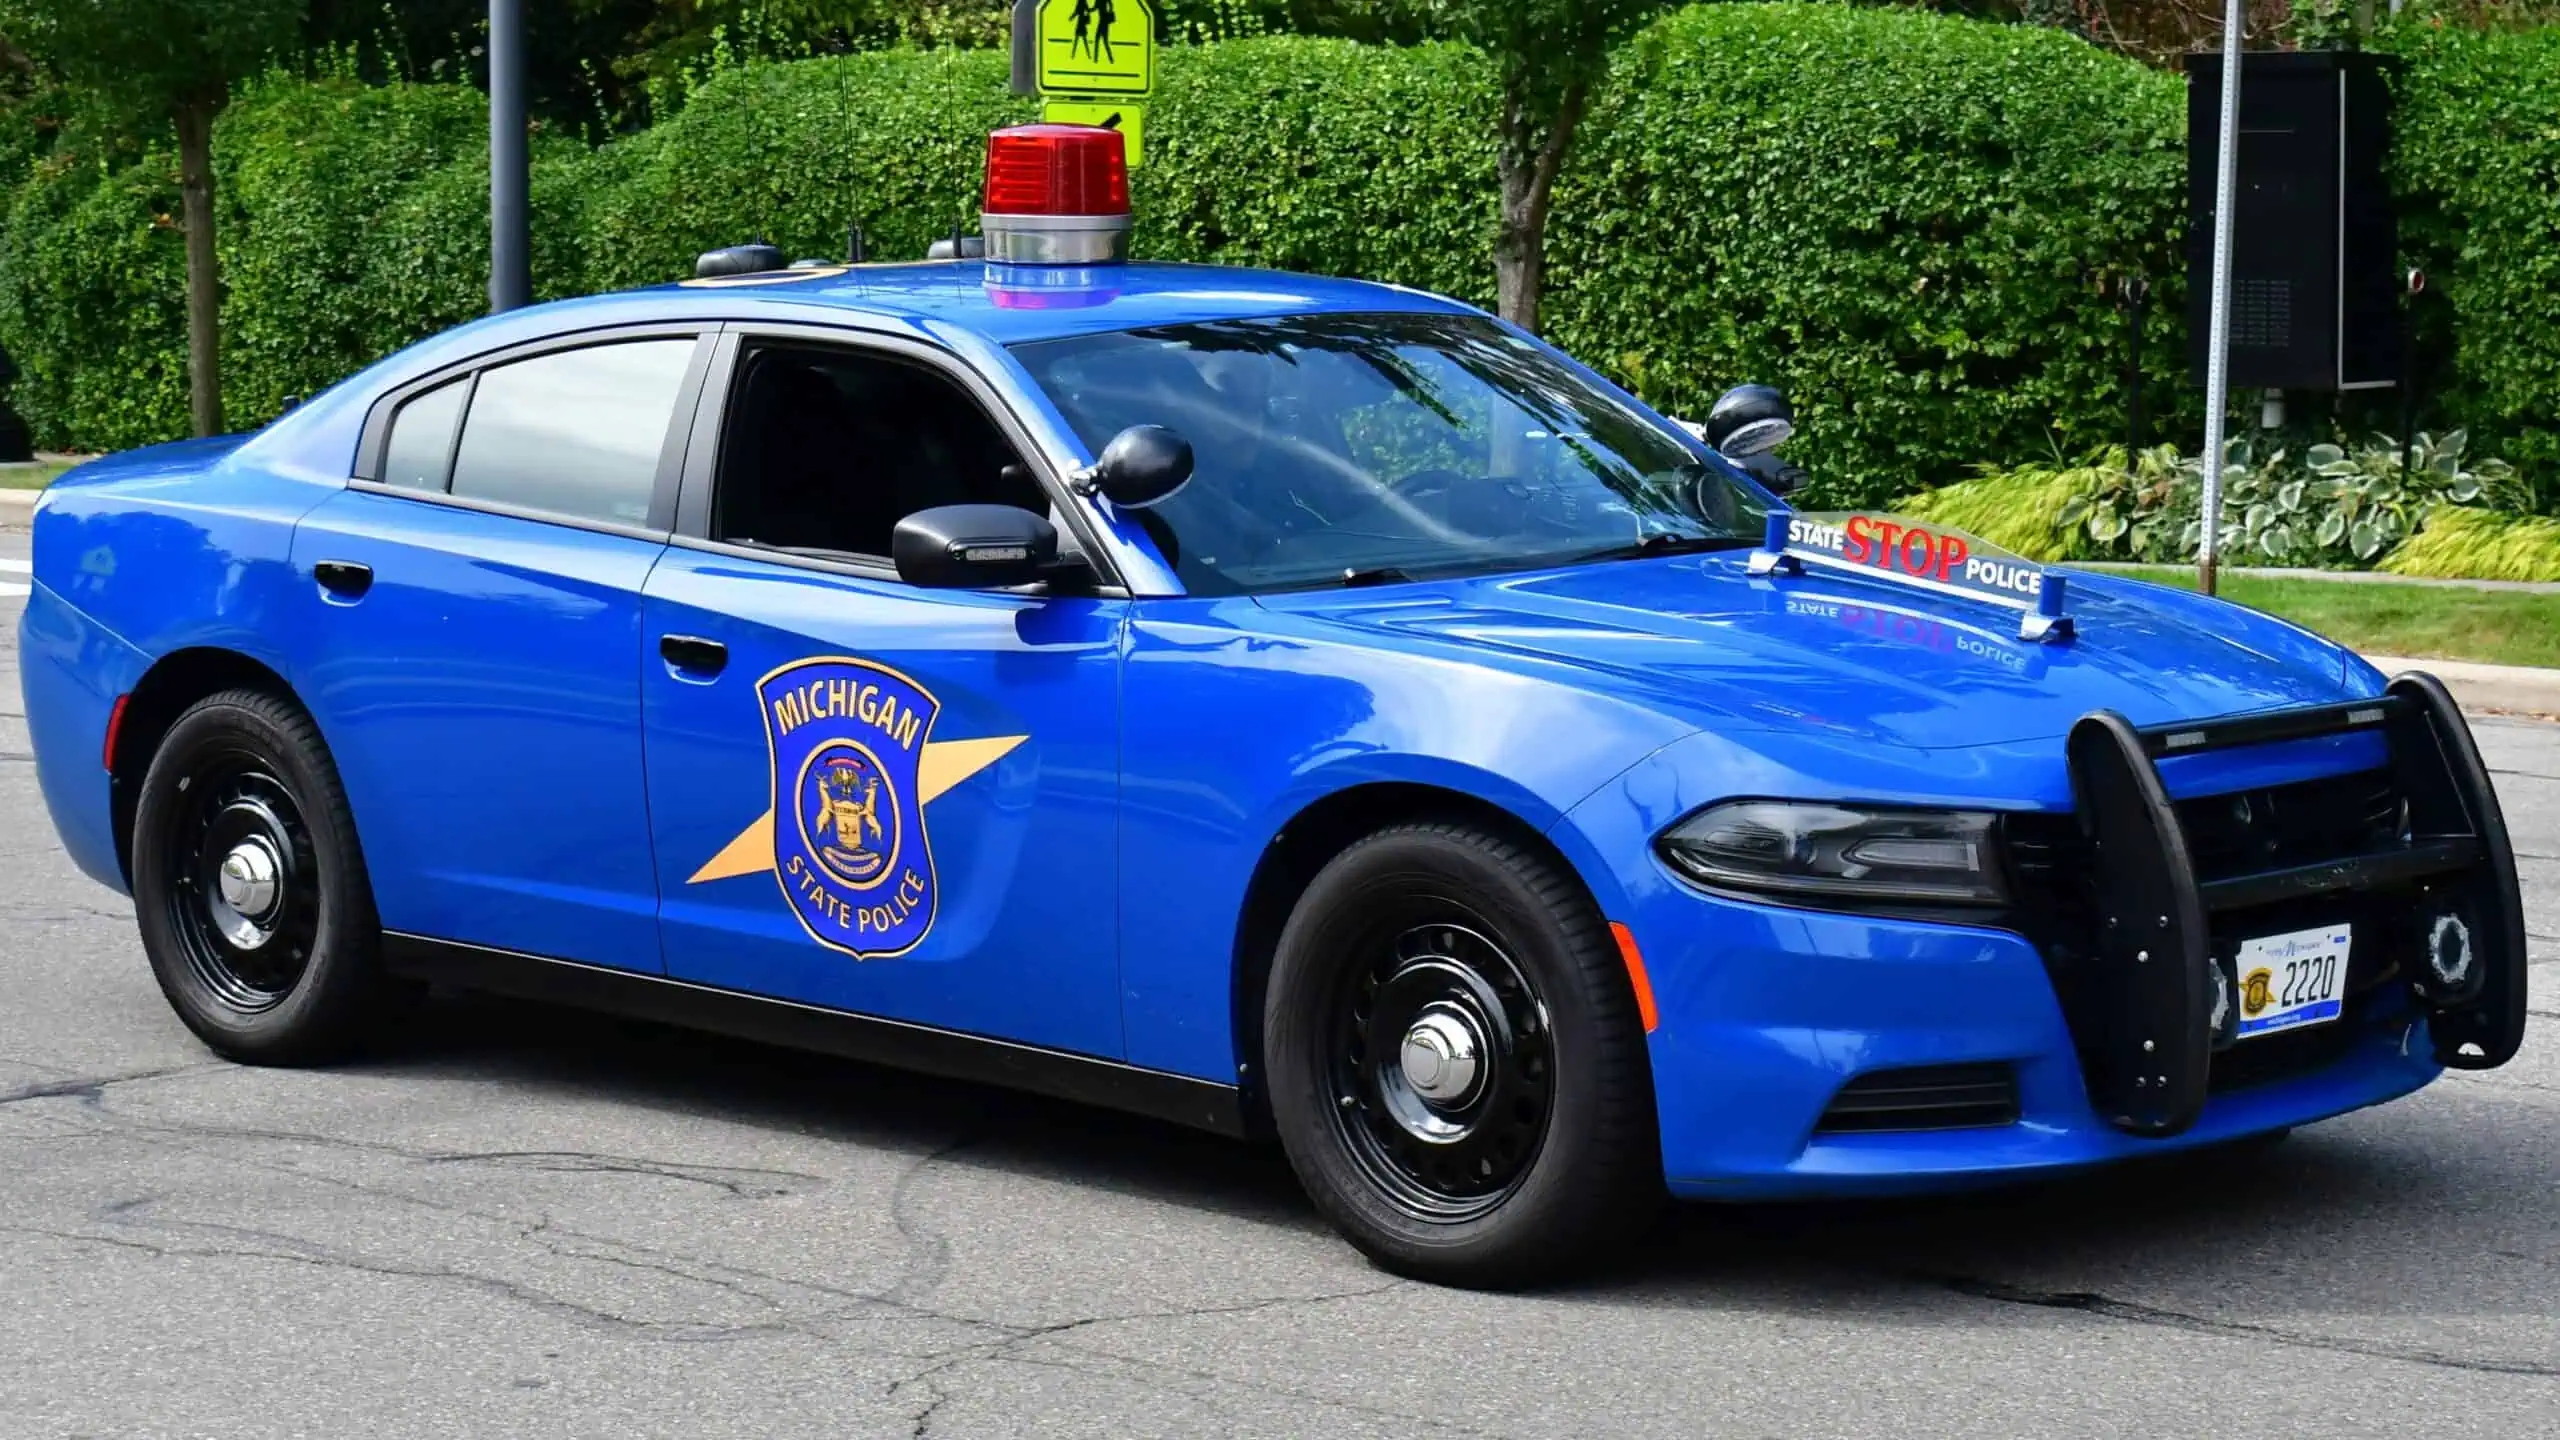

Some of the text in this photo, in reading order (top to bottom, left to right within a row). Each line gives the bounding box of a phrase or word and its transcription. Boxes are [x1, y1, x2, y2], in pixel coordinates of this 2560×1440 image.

[1788, 516, 2041, 594] STATE STOP POLICE
[774, 679, 921, 750] MICHIGAN
[786, 856, 850, 928] STATE
[859, 868, 925, 933] POLICE
[2282, 955, 2336, 1008] 2220
